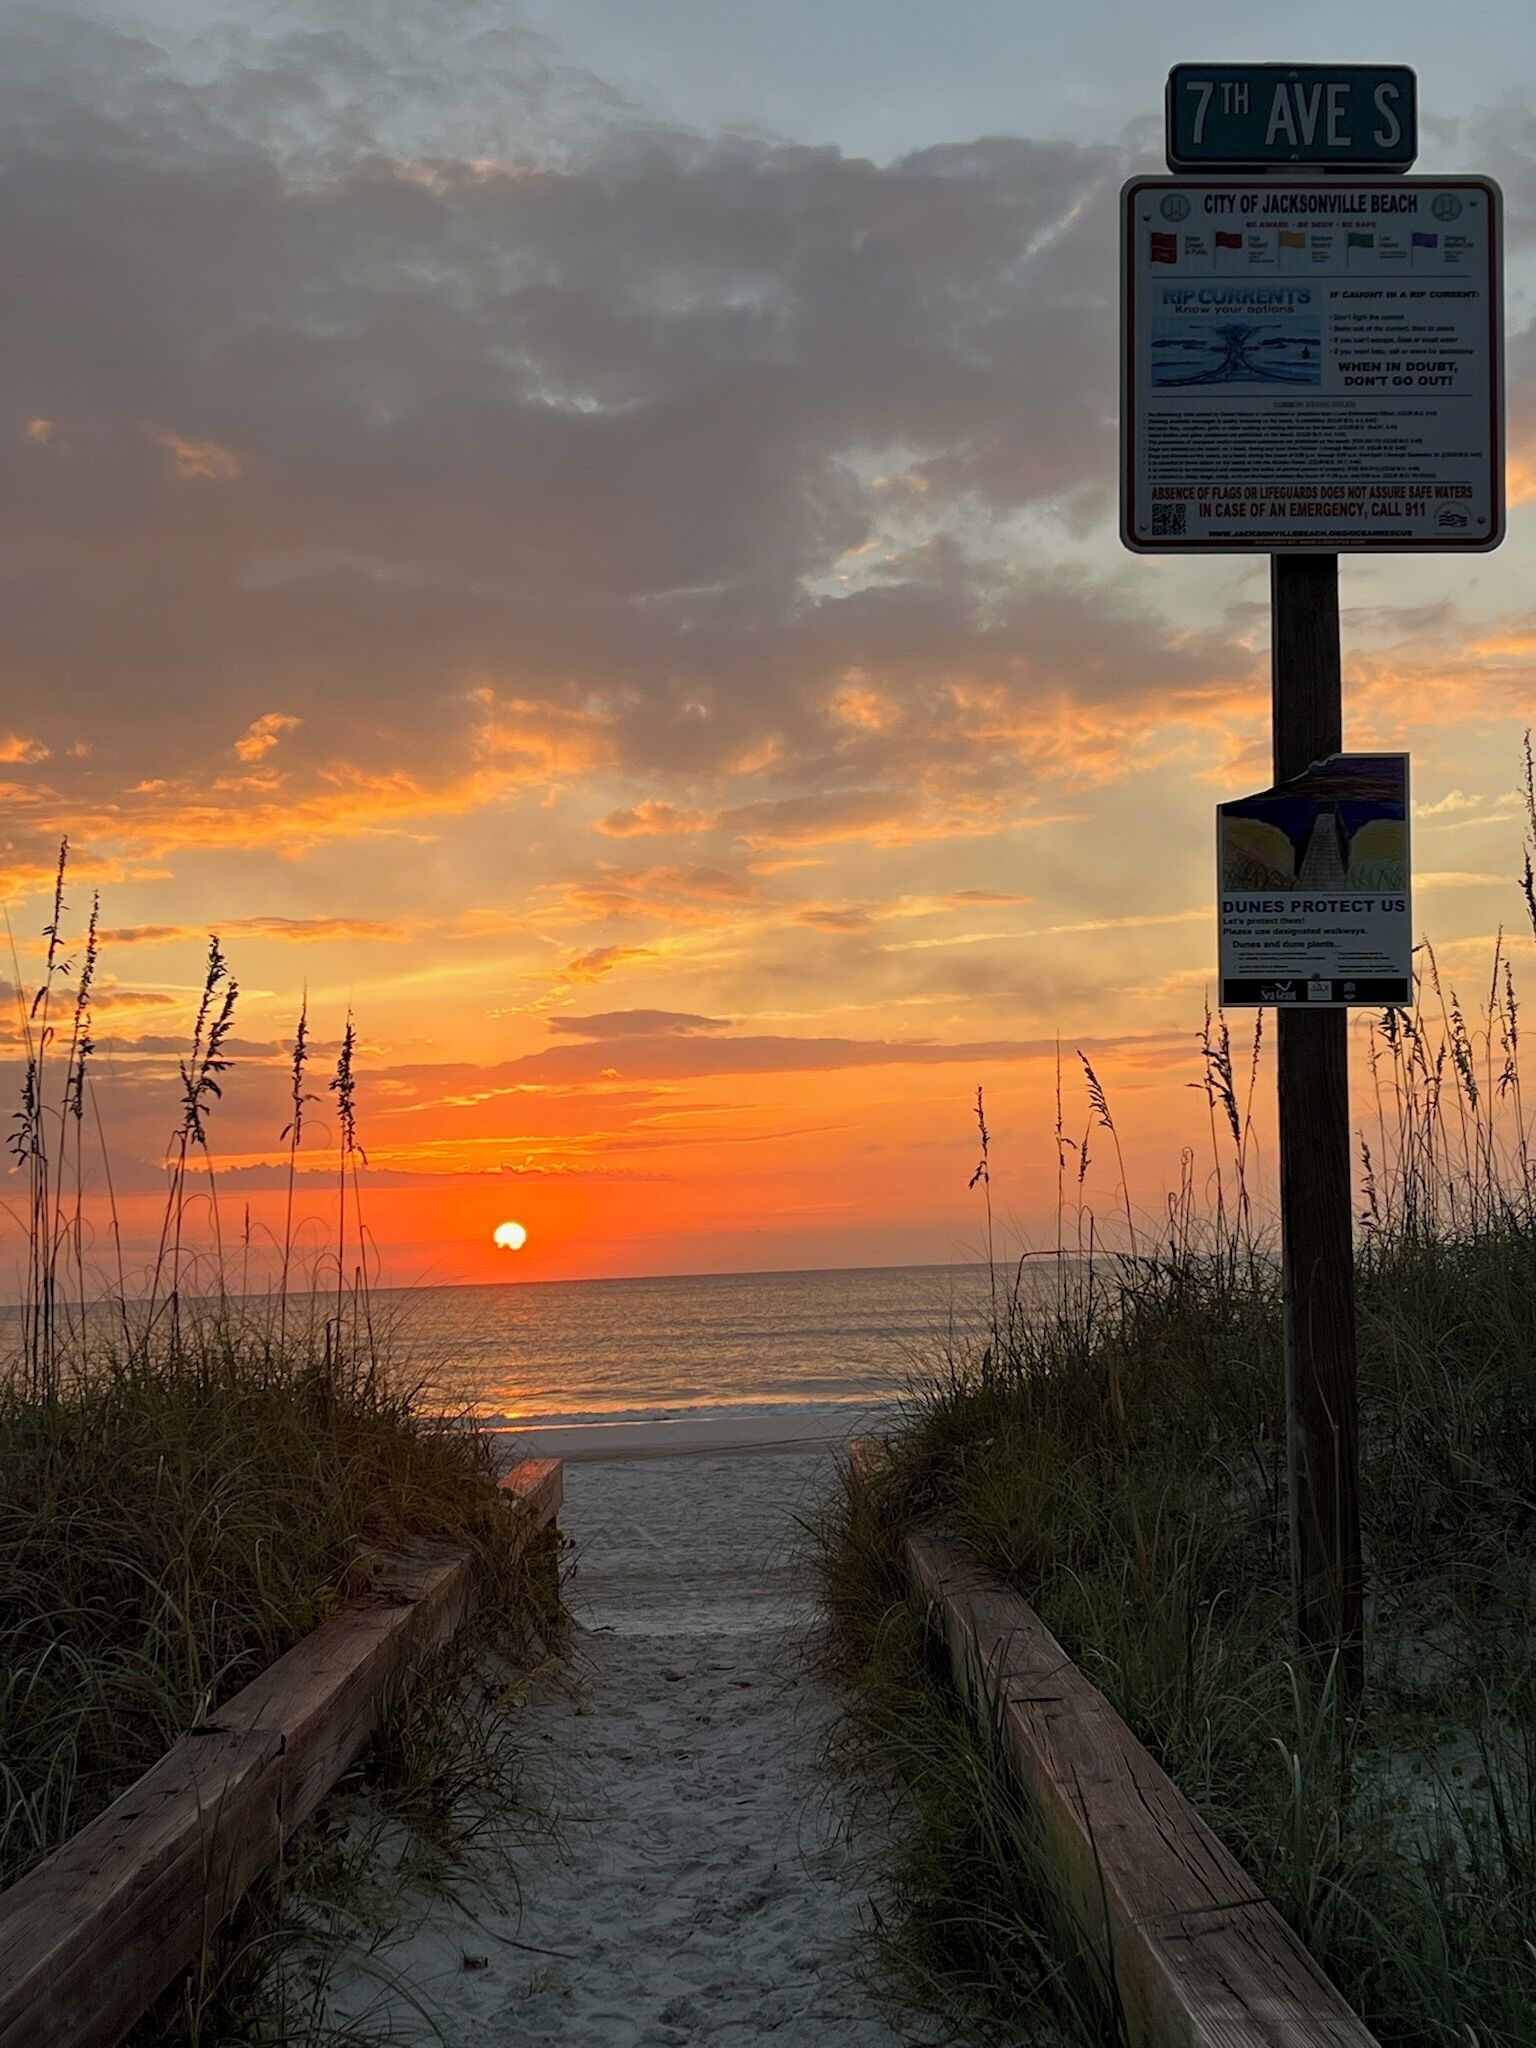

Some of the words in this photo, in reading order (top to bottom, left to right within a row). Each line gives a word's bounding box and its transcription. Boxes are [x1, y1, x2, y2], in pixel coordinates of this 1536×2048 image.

[1186, 81, 1249, 145] 7TH
[1264, 82, 1352, 146] AVE
[1373, 82, 1401, 148] S
[1204, 194, 1236, 213] CITY
[1240, 194, 1258, 213] OF
[1263, 194, 1366, 213] JACKSONVILLE
[1371, 194, 1418, 213] BEACH
[1162, 287, 1194, 304] RIP
[1198, 287, 1311, 304] CURRENTS
[1175, 305, 1209, 313] Know
[1215, 306, 1241, 314] your
[1247, 305, 1294, 314] options
[1338, 362, 1380, 371] WHEN
[1386, 362, 1400, 371] IN
[1406, 362, 1458, 373] DOUBT,
[1344, 376, 1388, 386] DON'T
[1392, 376, 1413, 386] GO
[1418, 376, 1452, 386] OUT!
[1152, 487, 1194, 500] ABSENCE
[1198, 487, 1209, 499] OF
[1213, 487, 1242, 499] FLAGS
[1244, 487, 1257, 499] OR
[1260, 487, 1317, 499] LIFEGUARDS
[1321, 486, 1344, 499] DOES
[1348, 486, 1367, 498] NOT
[1370, 486, 1405, 498] ASSURE
[1409, 486, 1432, 498] SAFE
[1435, 486, 1472, 498] WATERS
[1200, 503, 1211, 517] IN
[1215, 503, 1246, 517] CASE
[1250, 503, 1265, 517] OF
[1269, 503, 1285, 517] AN
[1290, 502, 1367, 520] EMERGENCY,
[1371, 502, 1401, 516] CALL
[1405, 502, 1425, 516] 911
[1223, 900, 1284, 913] DUNES
[1291, 900, 1374, 913] PROTECT
[1381, 900, 1406, 912] US
[1223, 917, 1244, 925] Let's
[1246, 917, 1277, 926] protect
[1280, 917, 1305, 925] them!
[1273, 928, 1321, 937] designated
[1323, 928, 1368, 937] walkways.
[1233, 940, 1261, 949] Dunes
[1264, 940, 1280, 949] and
[1283, 940, 1304, 949] dune
